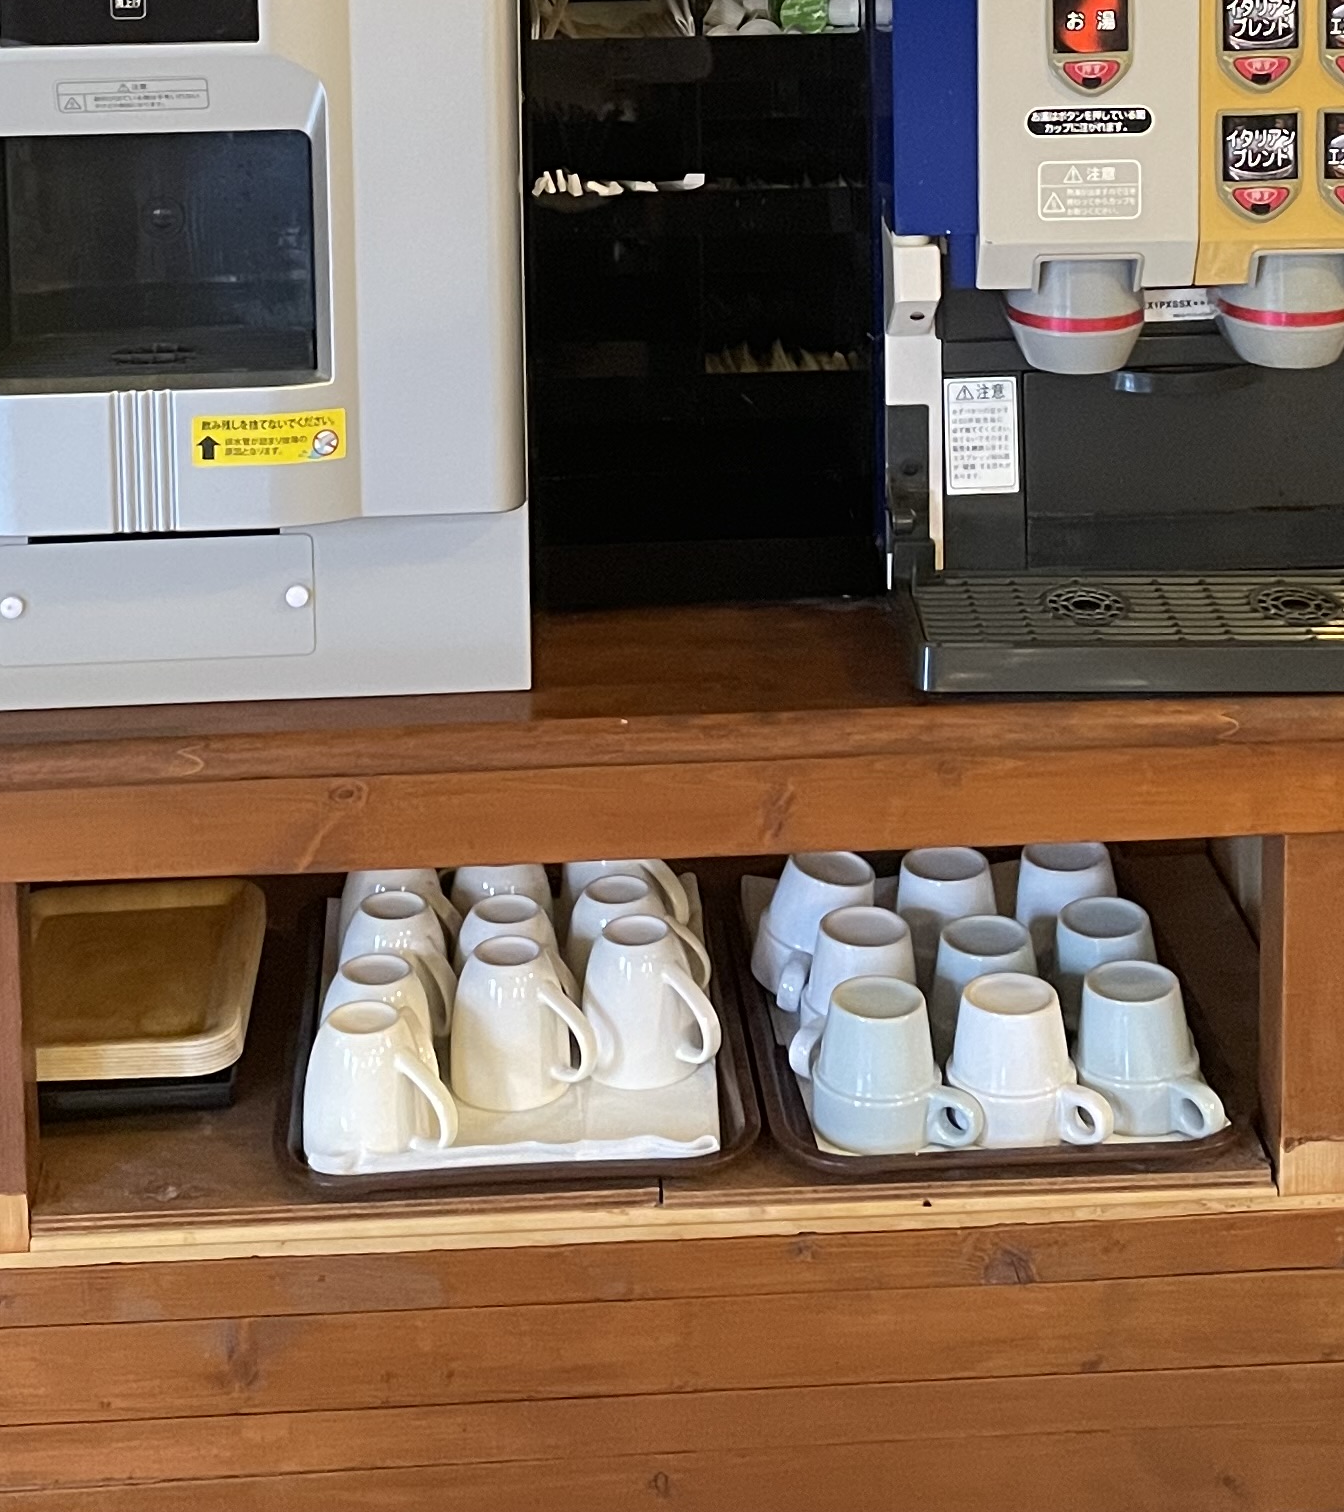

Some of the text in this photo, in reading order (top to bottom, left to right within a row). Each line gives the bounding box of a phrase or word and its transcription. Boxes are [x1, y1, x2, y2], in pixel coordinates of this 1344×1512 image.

[1065, 10, 1116, 31] お湯
[1233, 16, 1290, 37] ブレンド
[1226, 129, 1296, 148] イタリアン
[1233, 147, 1289, 168] ブレンド
[976, 383, 1006, 399] 注意
[201, 416, 336, 431] 飲み残しを捨てないでください。
